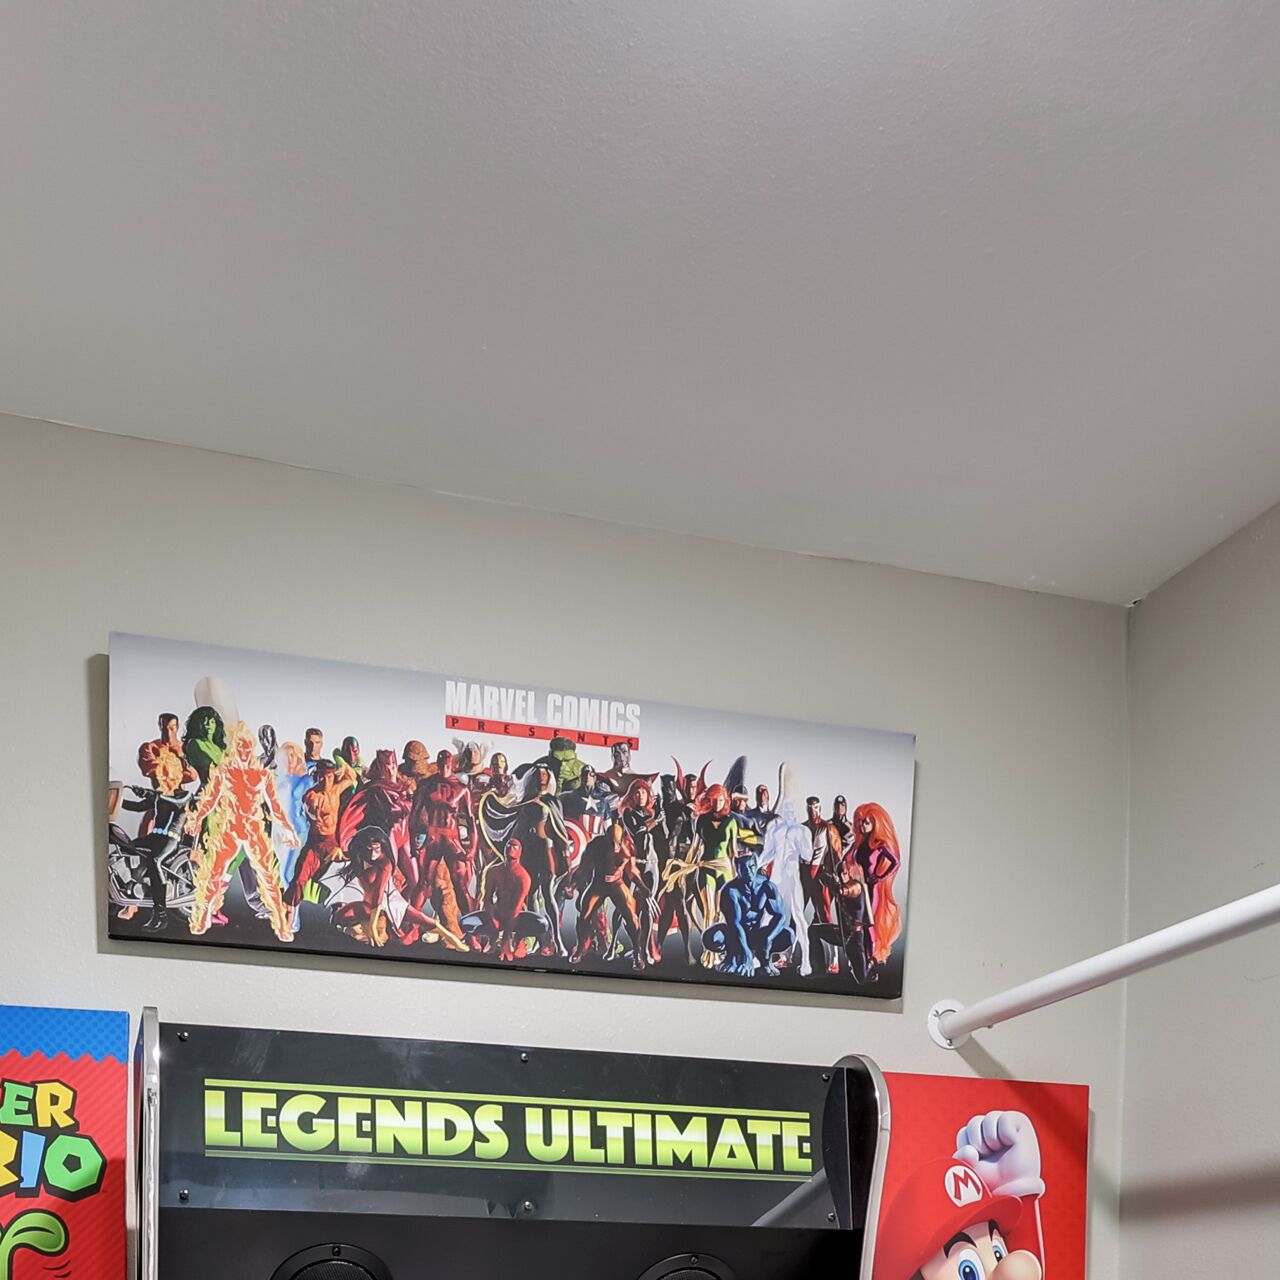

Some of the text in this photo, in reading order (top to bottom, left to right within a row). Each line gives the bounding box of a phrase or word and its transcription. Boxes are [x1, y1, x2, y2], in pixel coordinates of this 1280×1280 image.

[446, 680, 640, 735] MARVEL COMICS
[452, 718, 633, 748] PRESENTS
[204, 1089, 813, 1173] LEGENDS ULTIMATE
